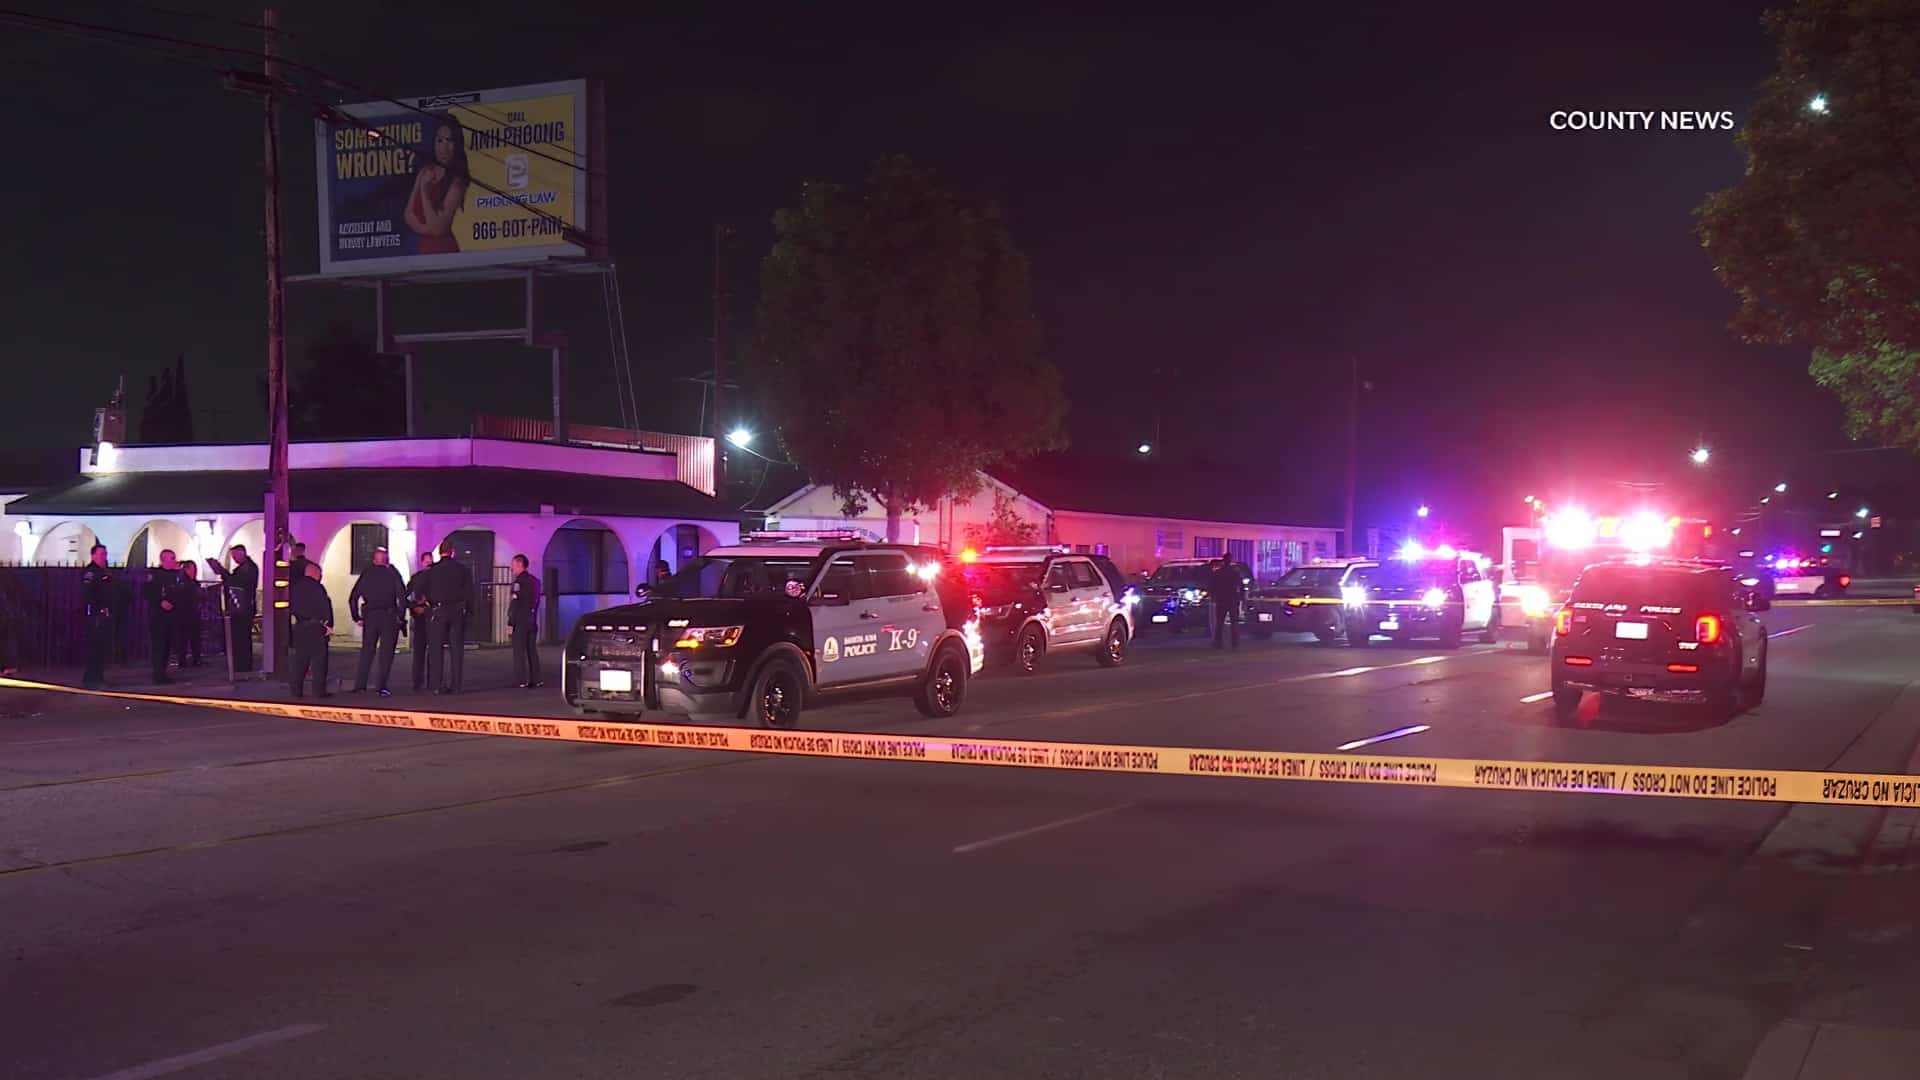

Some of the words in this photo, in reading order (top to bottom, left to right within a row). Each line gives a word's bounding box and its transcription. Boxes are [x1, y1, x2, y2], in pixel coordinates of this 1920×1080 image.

[335, 122, 421, 151] SOMETHING
[336, 149, 416, 179] WRONG?
[528, 192, 556, 205] LAW
[889, 628, 917, 651] K-9
[844, 643, 877, 657] POLICE
[1060, 749, 1082, 765] CROSS
[1113, 751, 1130, 768] LINE
[1132, 752, 1158, 769] POLICE
[1189, 754, 1219, 772] CRUZAR
[1281, 758, 1305, 776] LINEA
[1309, 759, 1315, 777] /
[1319, 759, 1346, 778] CROSS
[1348, 761, 1366, 779] NOT
[1474, 765, 1511, 785] CRUZAR
[1514, 767, 1527, 785] NO
[1530, 767, 1568, 787] POLICIA
[1571, 769, 1583, 788] DE
[1586, 770, 1615, 789] LINEA
[1620, 771, 1627, 790] /
[1632, 772, 1666, 791] CROSS
[1669, 773, 1690, 793] NOT
[1692, 774, 1707, 793] DO
[1710, 775, 1734, 794] LINE
[1738, 776, 1776, 796] POLICE
[1822, 779, 1868, 800] CRUZAR
[1893, 782, 1920, 802] ICIA
